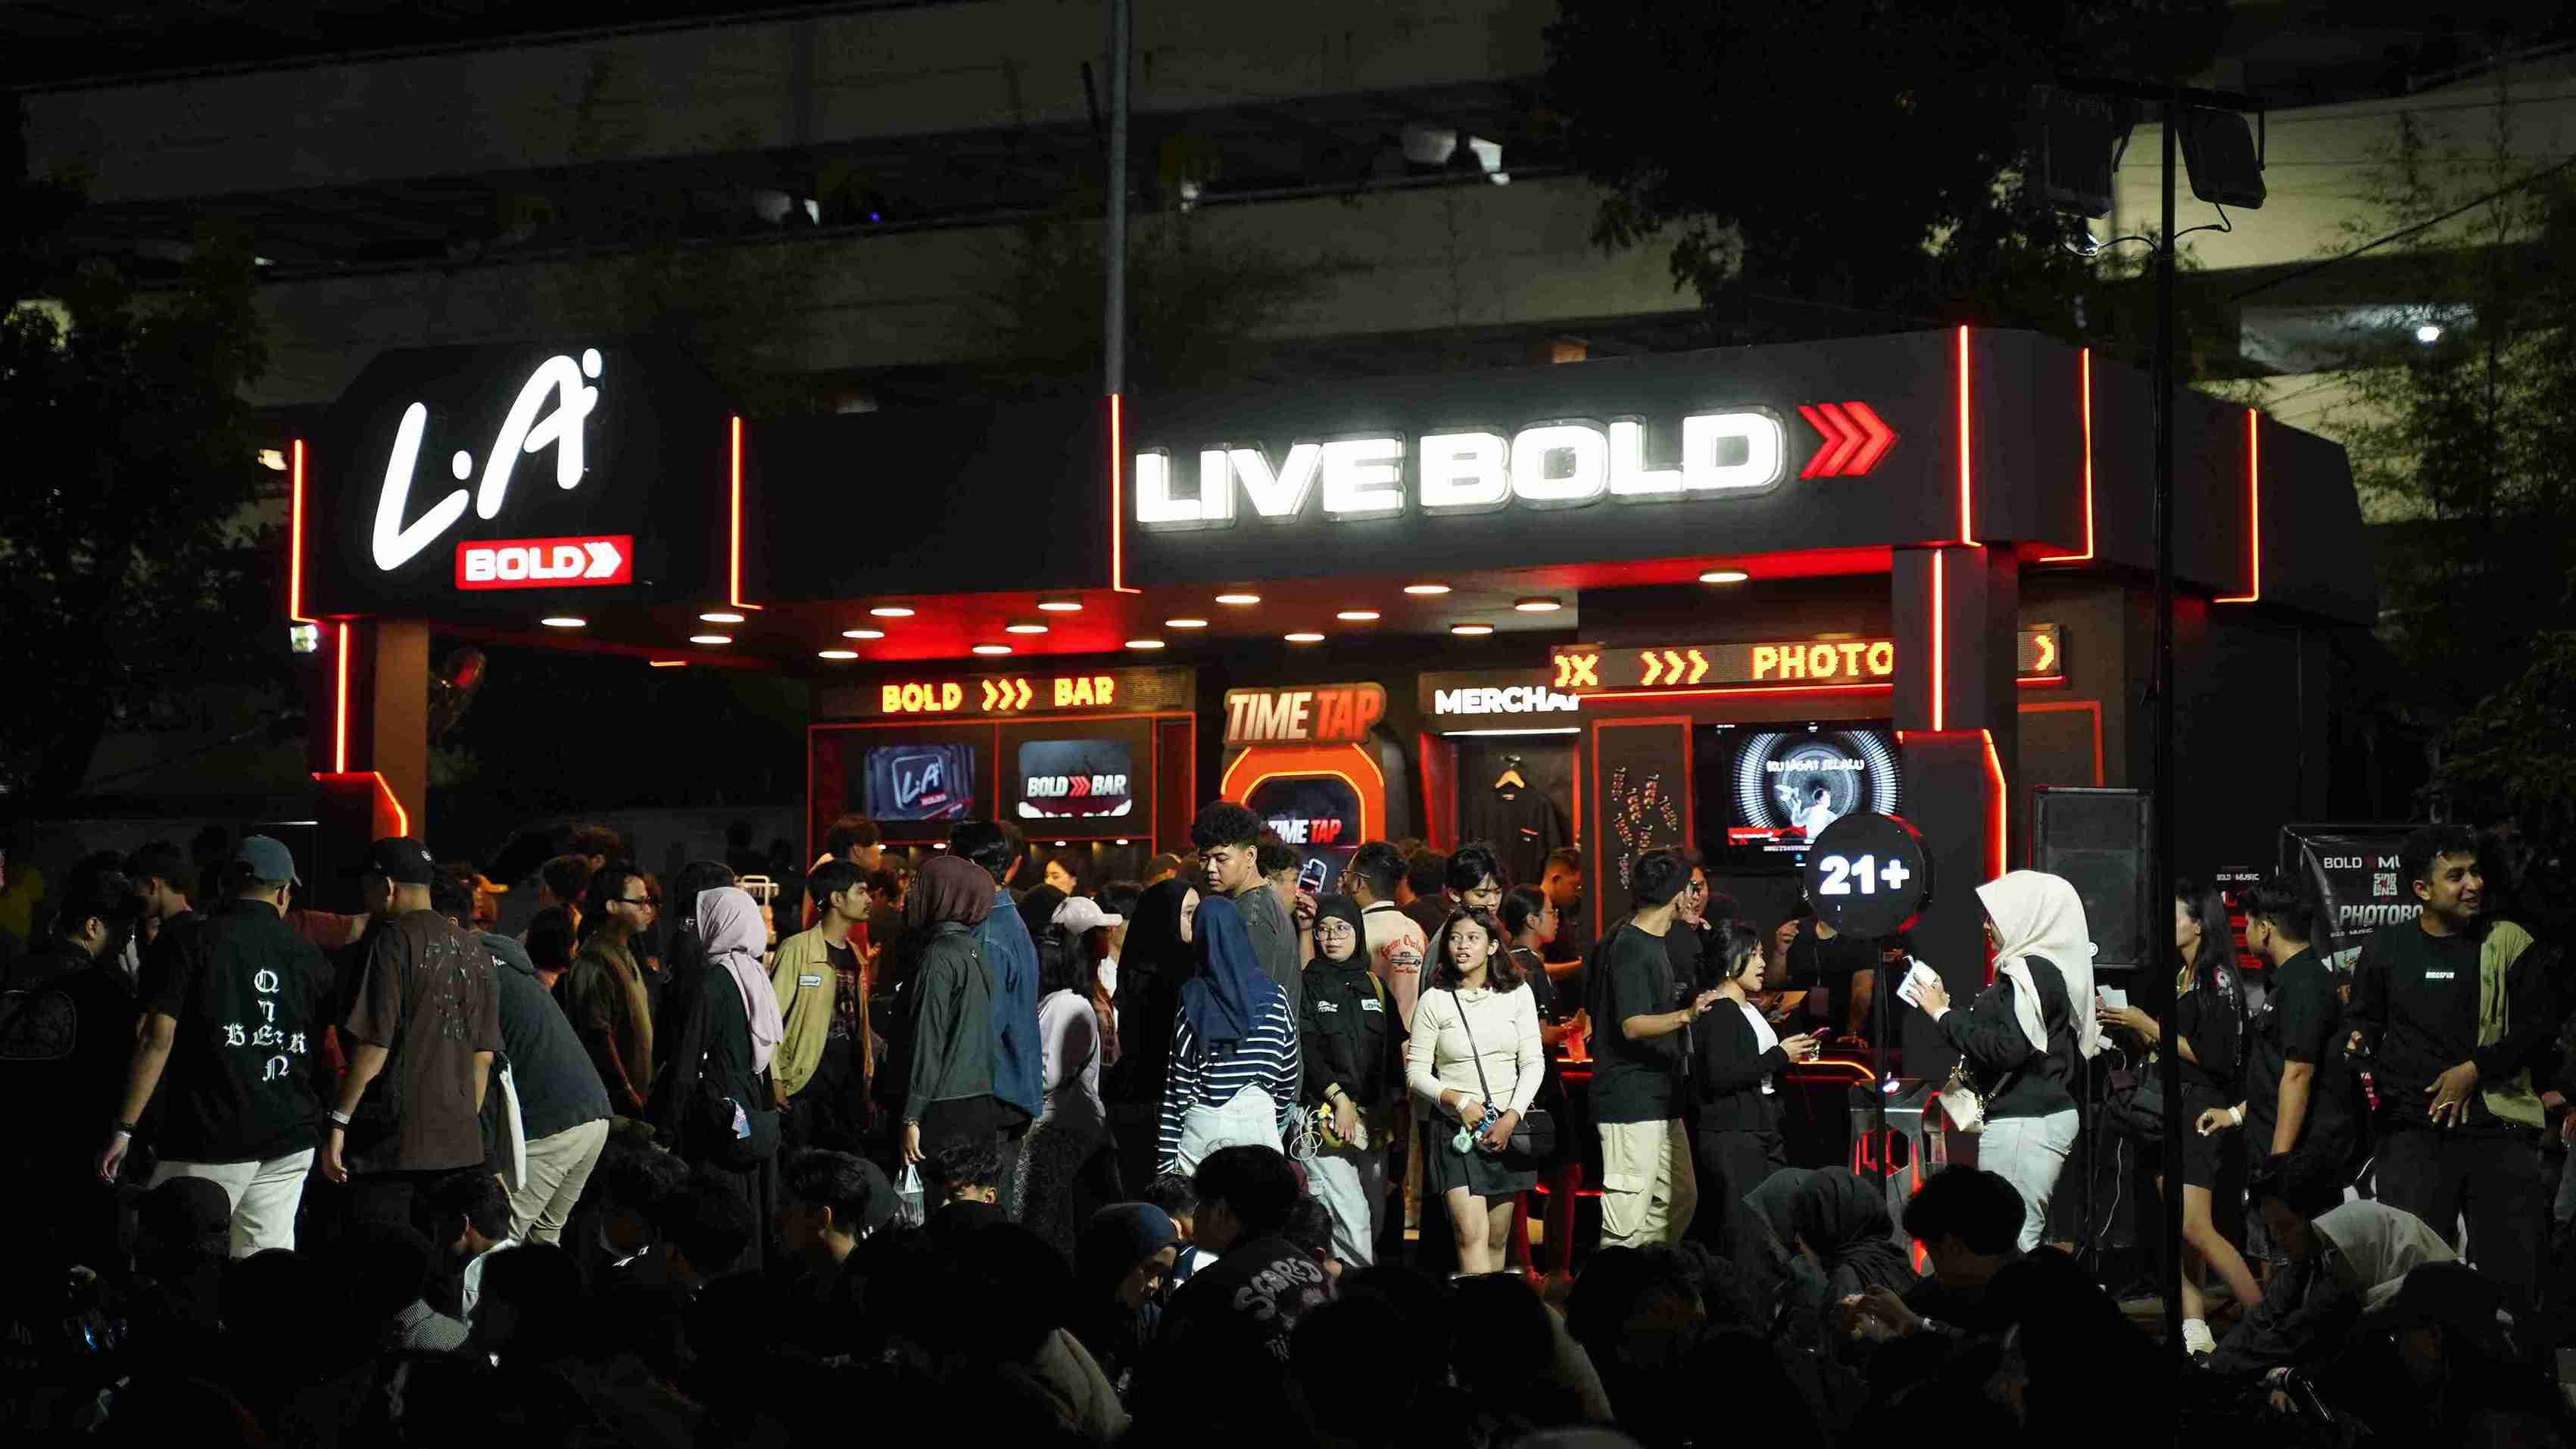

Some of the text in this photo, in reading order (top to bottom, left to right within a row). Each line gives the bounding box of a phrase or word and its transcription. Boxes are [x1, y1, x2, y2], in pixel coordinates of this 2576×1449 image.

[1136, 404, 1787, 531] LIVE BOLD
[464, 544, 586, 581] BOLD
[1751, 641, 1894, 680] PHOTO
[881, 676, 1115, 713] BOLD BAR
[1227, 687, 1381, 741] TIME TAP
[1026, 774, 1127, 797] BOLD BAR
[1310, 818, 1343, 844] TAP
[1819, 854, 1910, 896] 21+
[2235, 873, 2260, 881] MUSIC
[2323, 856, 2362, 869] BOLD
